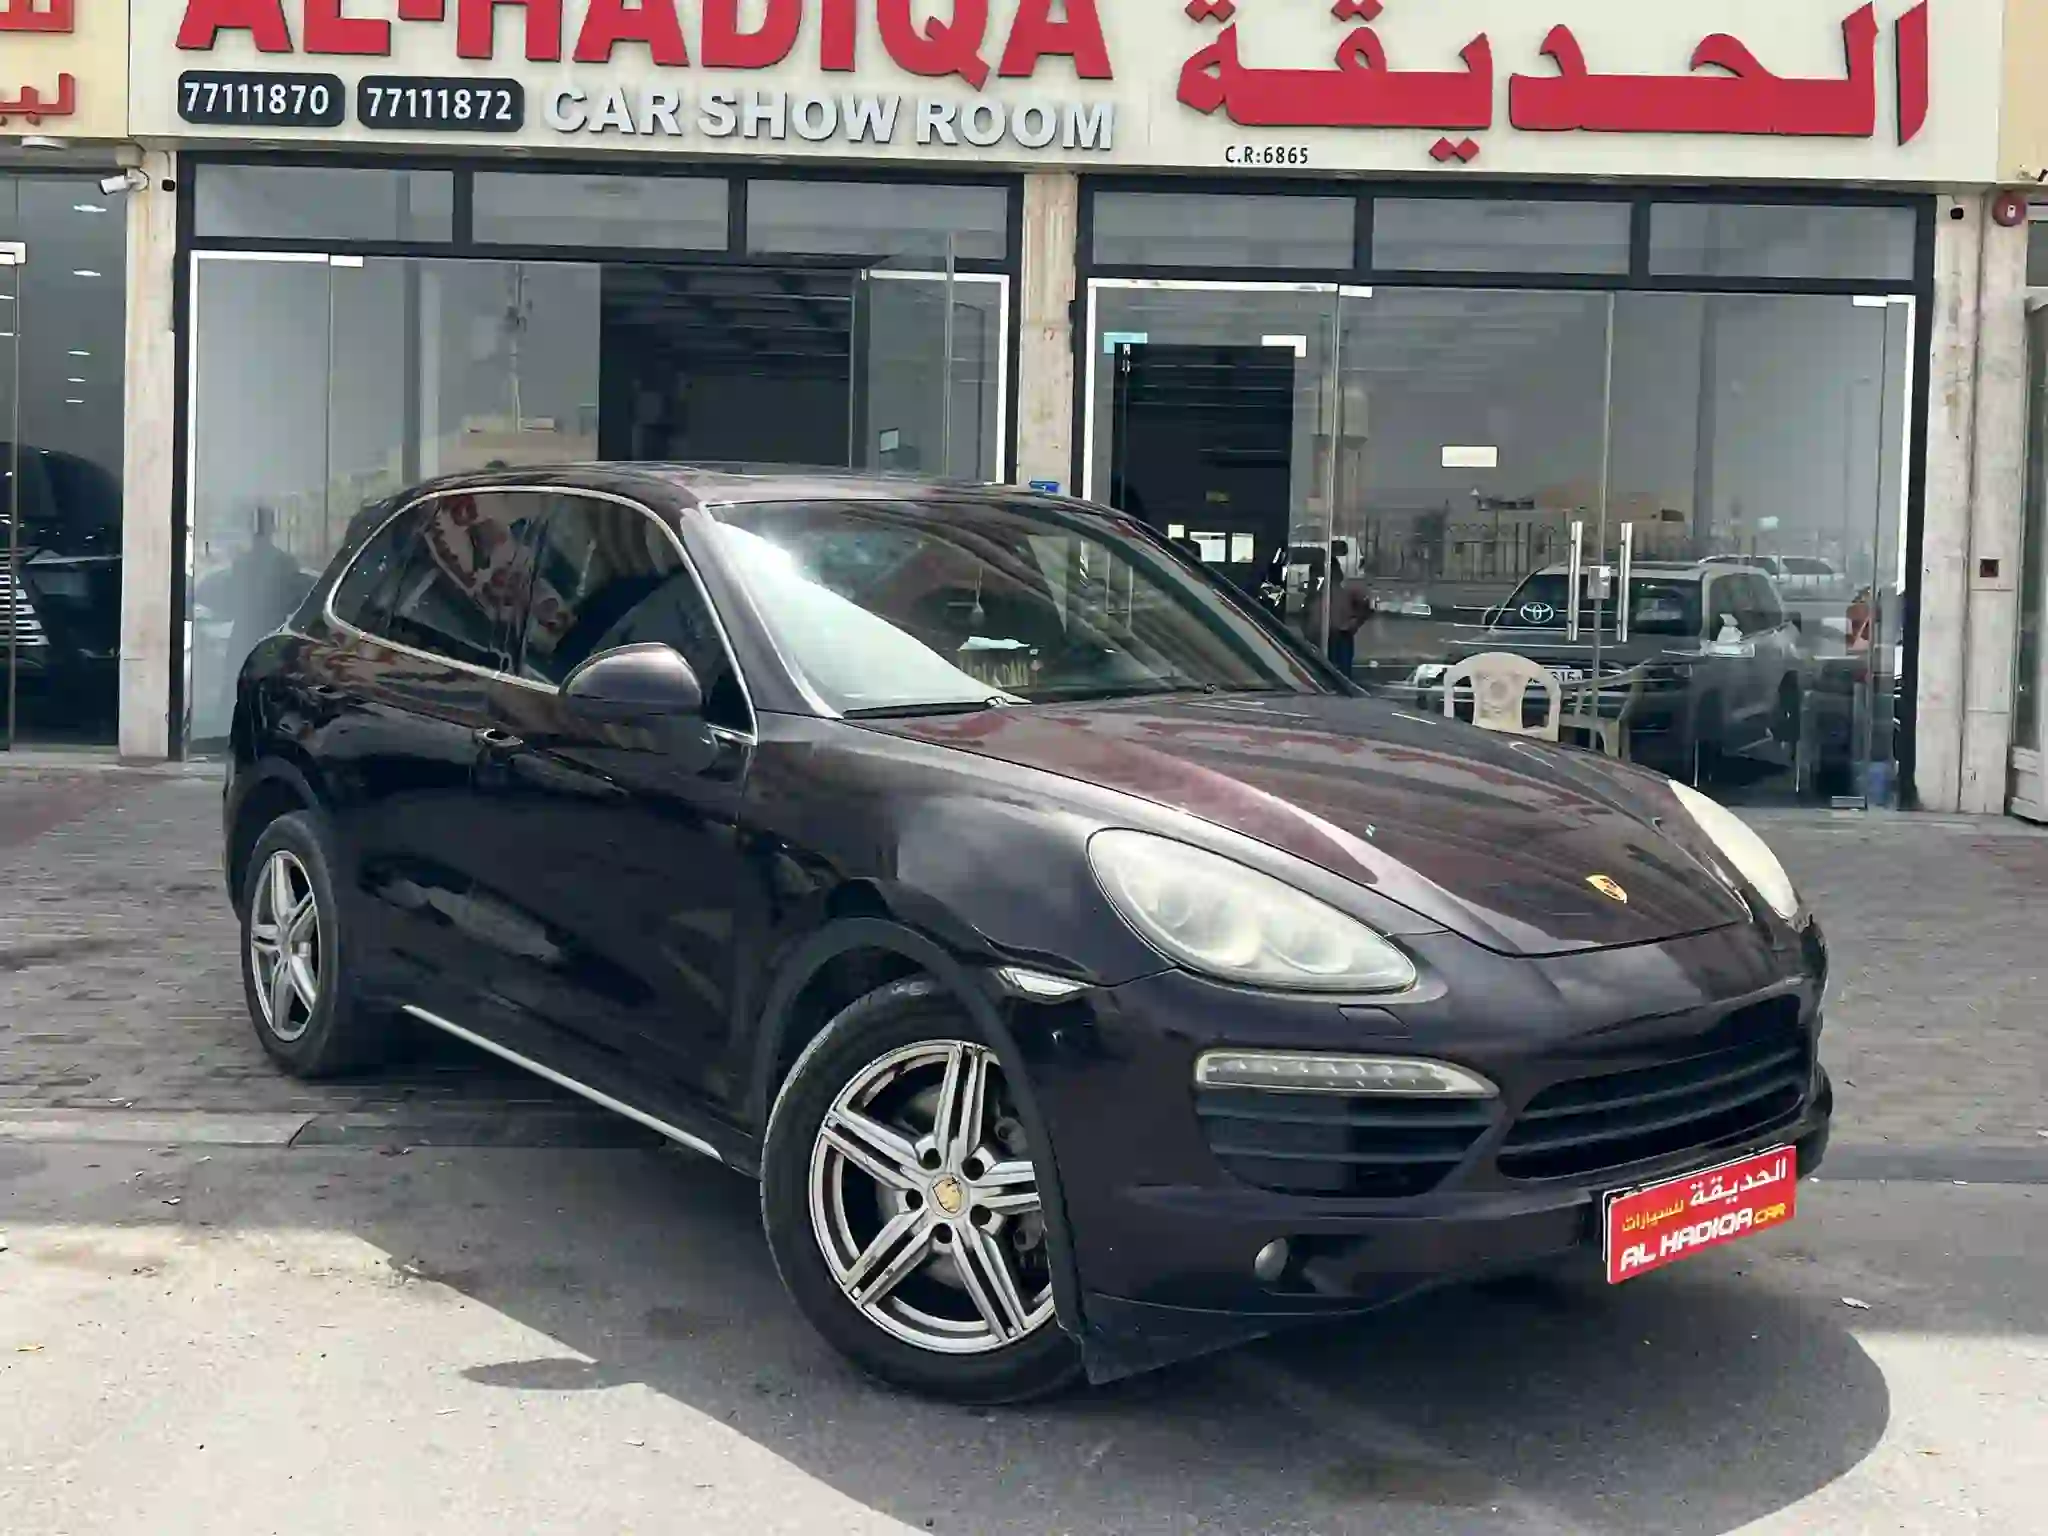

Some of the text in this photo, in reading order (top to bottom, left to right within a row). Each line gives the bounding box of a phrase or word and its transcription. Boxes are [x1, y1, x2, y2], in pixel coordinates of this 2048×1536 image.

[183, 82, 330, 115] 77111870
[366, 87, 513, 121] 77111872
[1176, 0, 1928, 163] الحديقة
[544, 86, 1115, 150] CAR SHOW ROOM
[1225, 146, 1308, 164] C.R:6865
[1621, 1157, 1788, 1232] الحديقة للسيارات
[1620, 1203, 1787, 1272] AL HADIQA CAR
